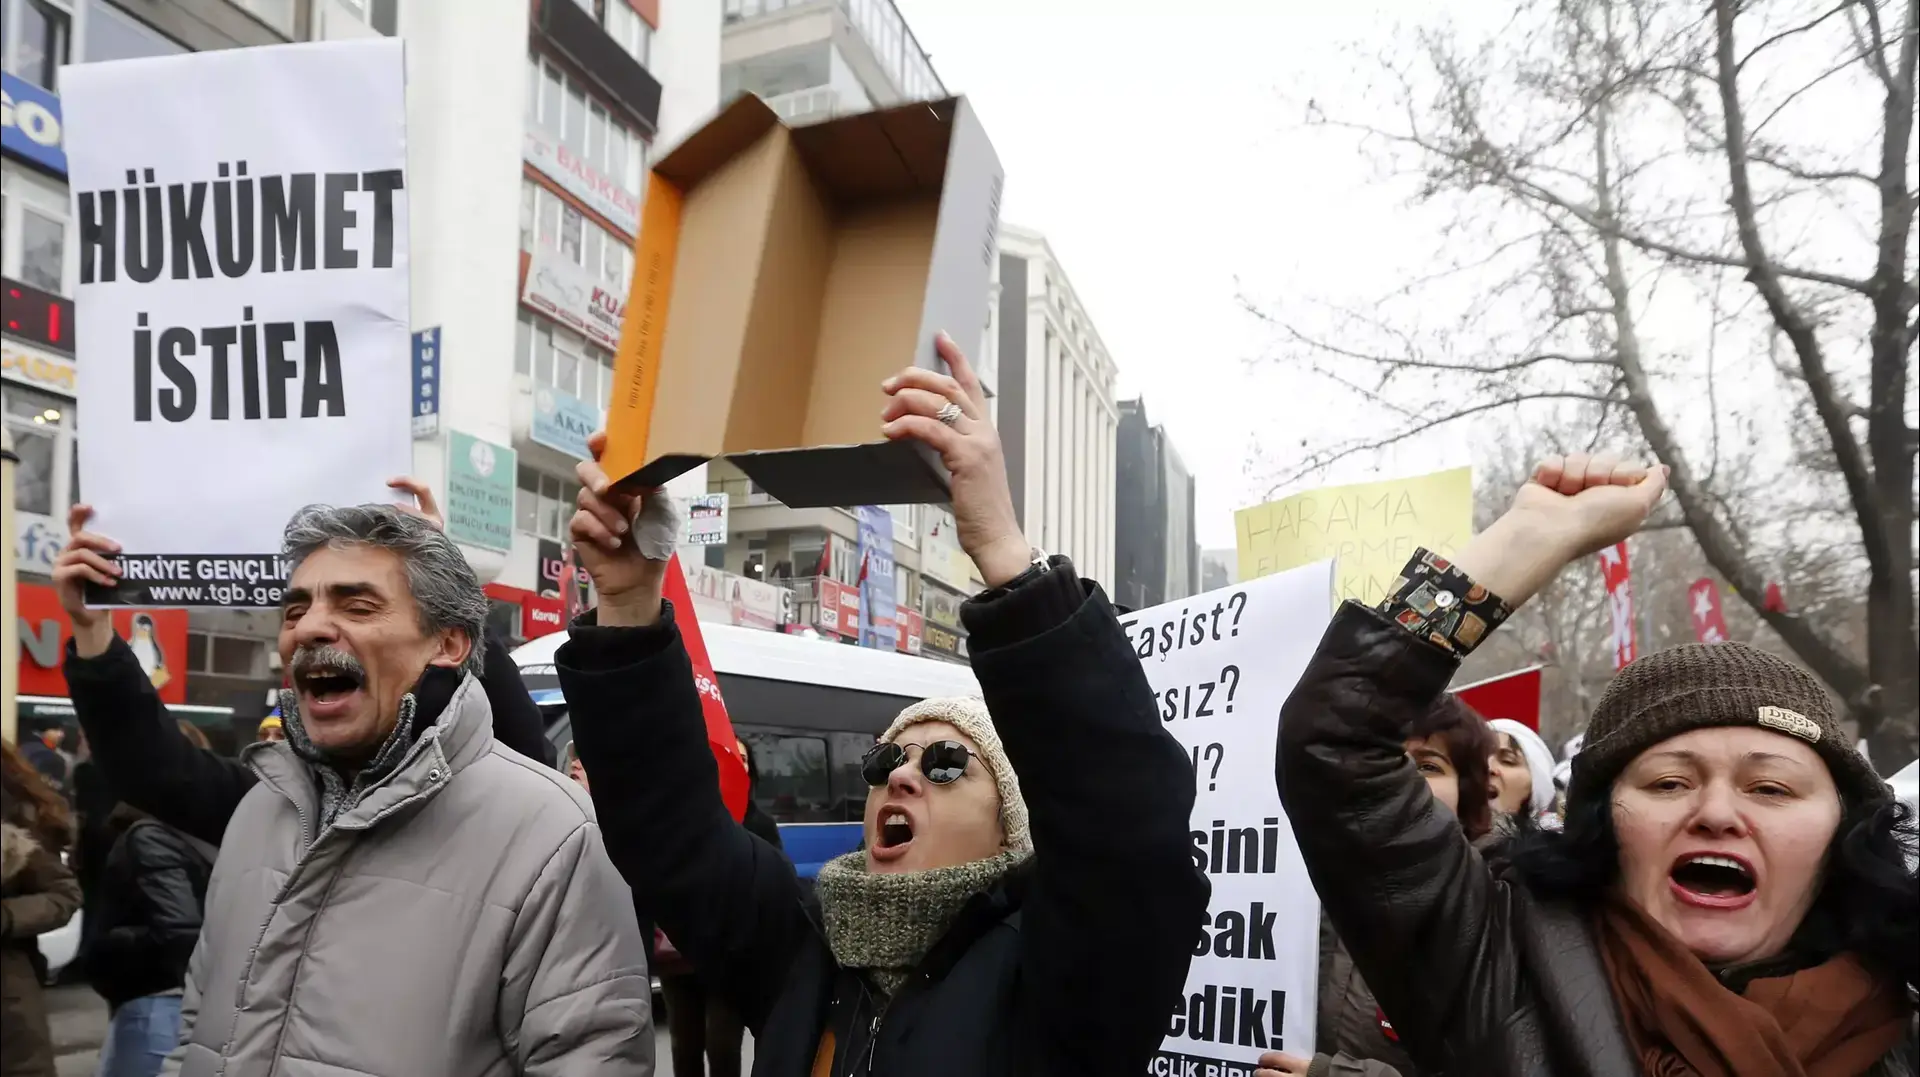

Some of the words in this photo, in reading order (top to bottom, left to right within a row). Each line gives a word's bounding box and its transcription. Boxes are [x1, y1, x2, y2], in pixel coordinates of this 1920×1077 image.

[77, 160, 404, 285] HÜKÜMET
[133, 306, 346, 423] İSTİFA
[1246, 489, 1420, 552] HARAMA
[113, 556, 191, 580] ÜRKİYE
[1769, 708, 1814, 728] DEEP
